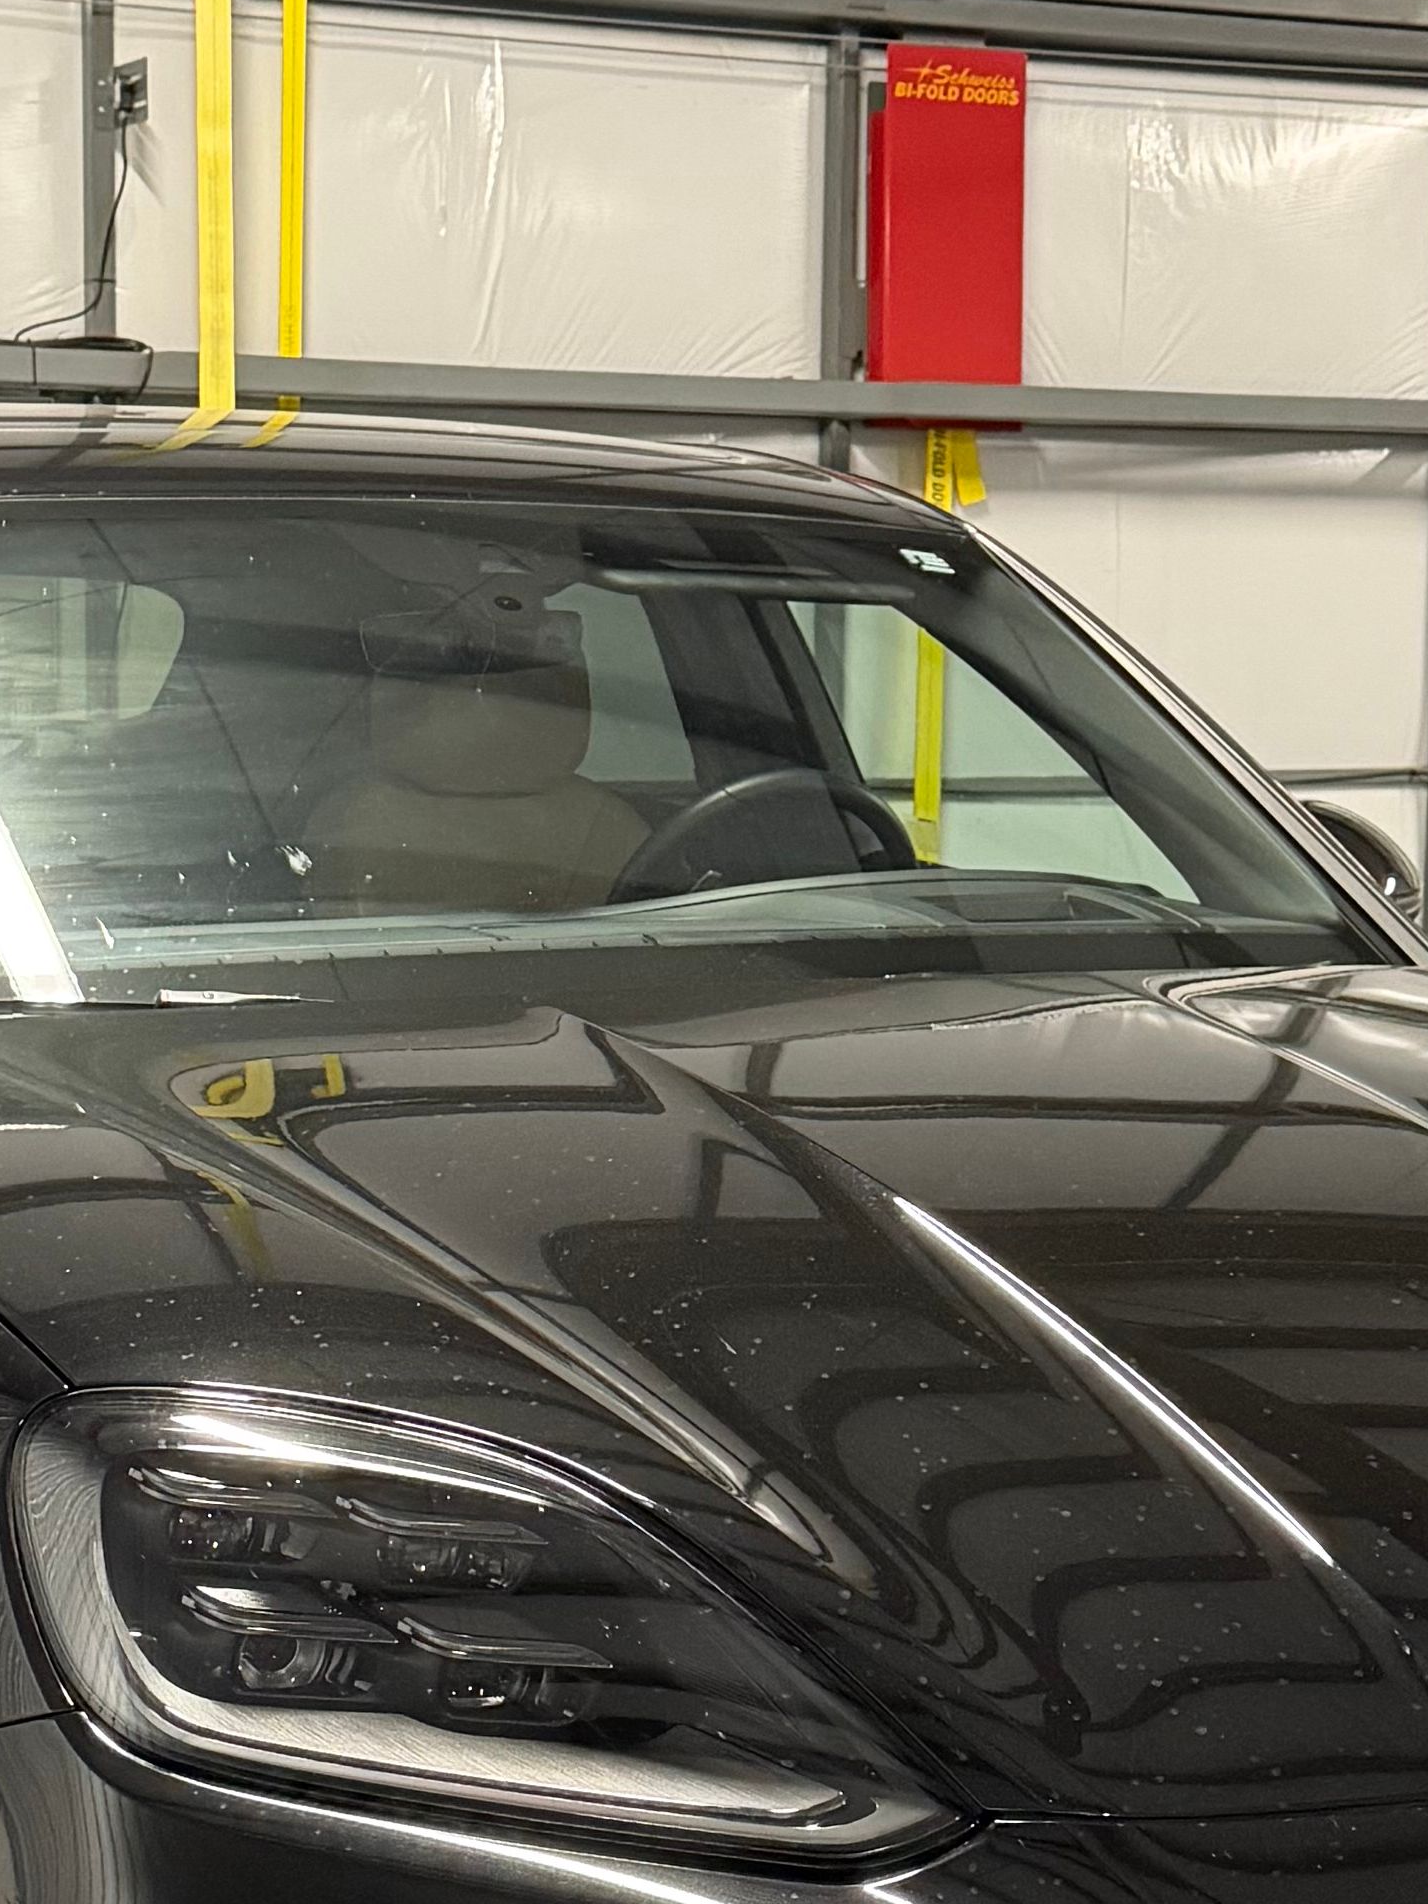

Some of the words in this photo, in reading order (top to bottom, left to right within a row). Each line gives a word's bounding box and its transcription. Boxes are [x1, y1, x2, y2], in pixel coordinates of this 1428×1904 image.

[932, 64, 1015, 89] Schweiss
[894, 81, 960, 101] BI-FOLD
[962, 87, 1020, 106] DOORS
